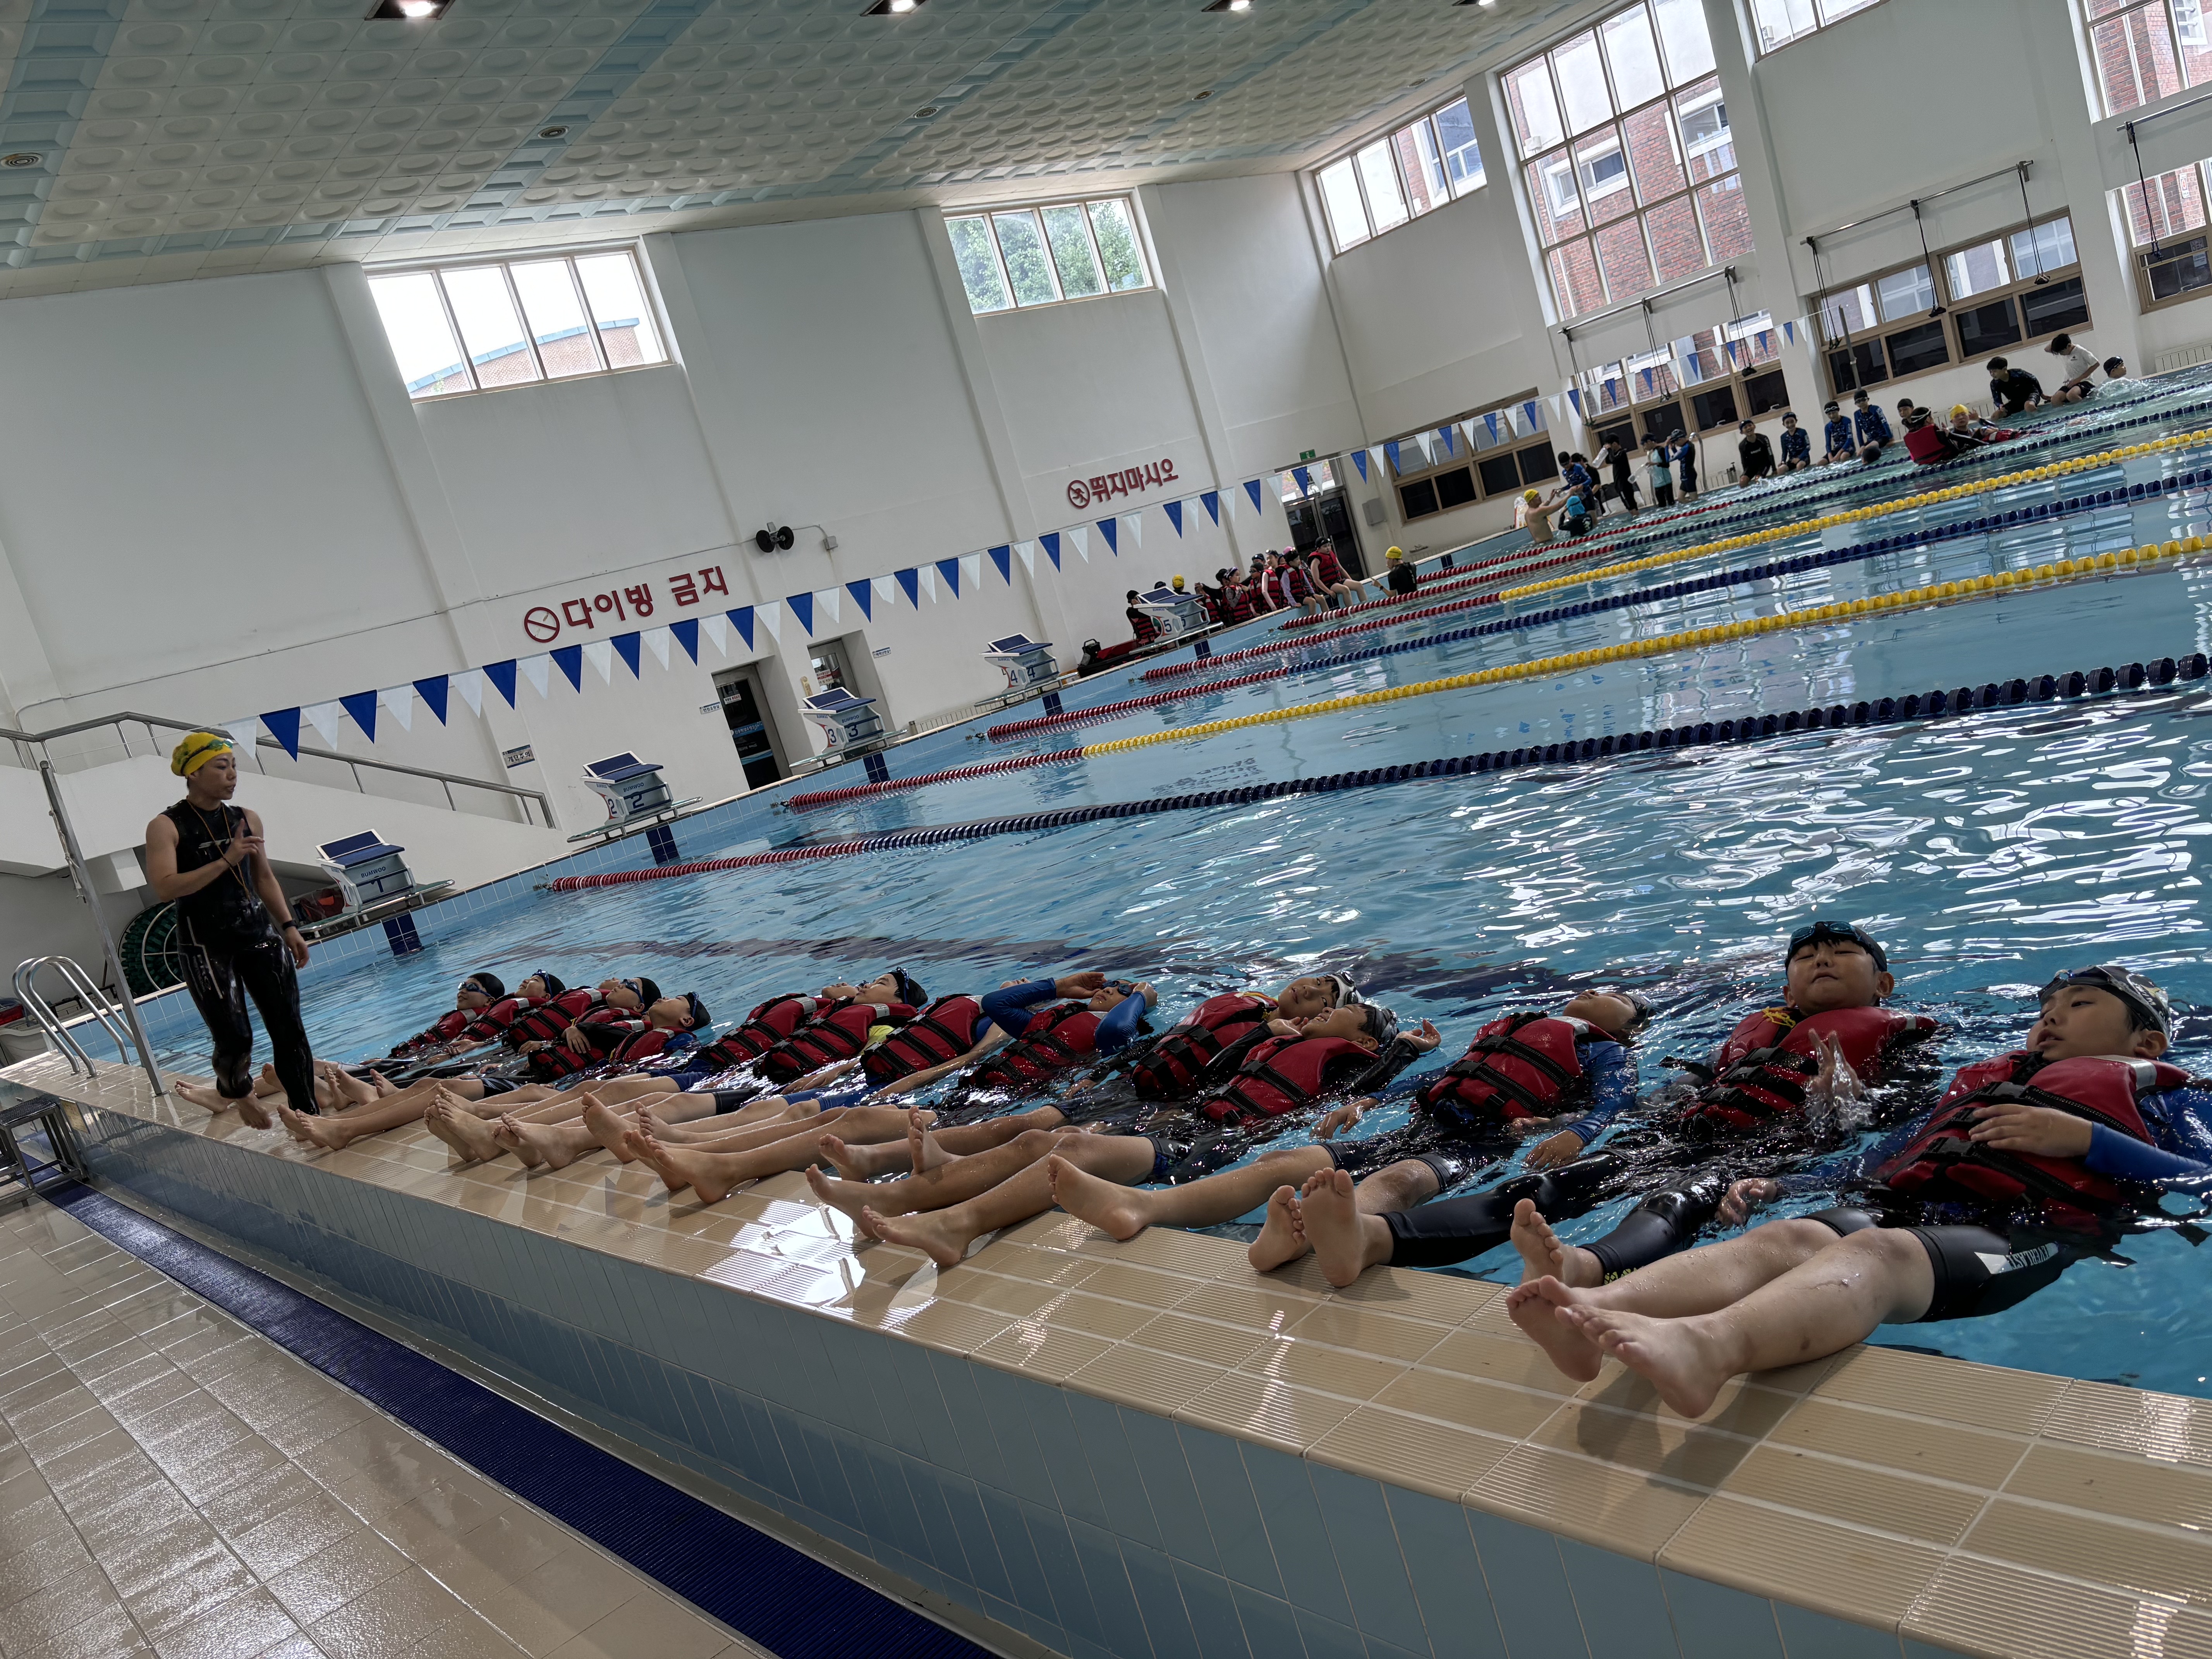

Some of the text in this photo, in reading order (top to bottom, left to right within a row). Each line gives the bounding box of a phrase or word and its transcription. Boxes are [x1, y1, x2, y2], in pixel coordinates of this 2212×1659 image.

[1089, 459, 1179, 503] 뛰지마시오
[561, 565, 729, 629] 다이빙 금지
[1163, 619, 1172, 632] 5
[1010, 670, 1018, 683] 4
[1027, 665, 1036, 678] 4
[842, 714, 859, 723] BUMWOO
[828, 728, 836, 744] 3
[847, 723, 859, 737] 3
[507, 751, 531, 762] 계단주의
[623, 782, 644, 793] BUMWOO
[608, 799, 617, 814] 2
[630, 792, 644, 809] 2
[361, 866, 386, 878] BUMWOO
[2006, 1245, 2049, 1270] EVERLAST
